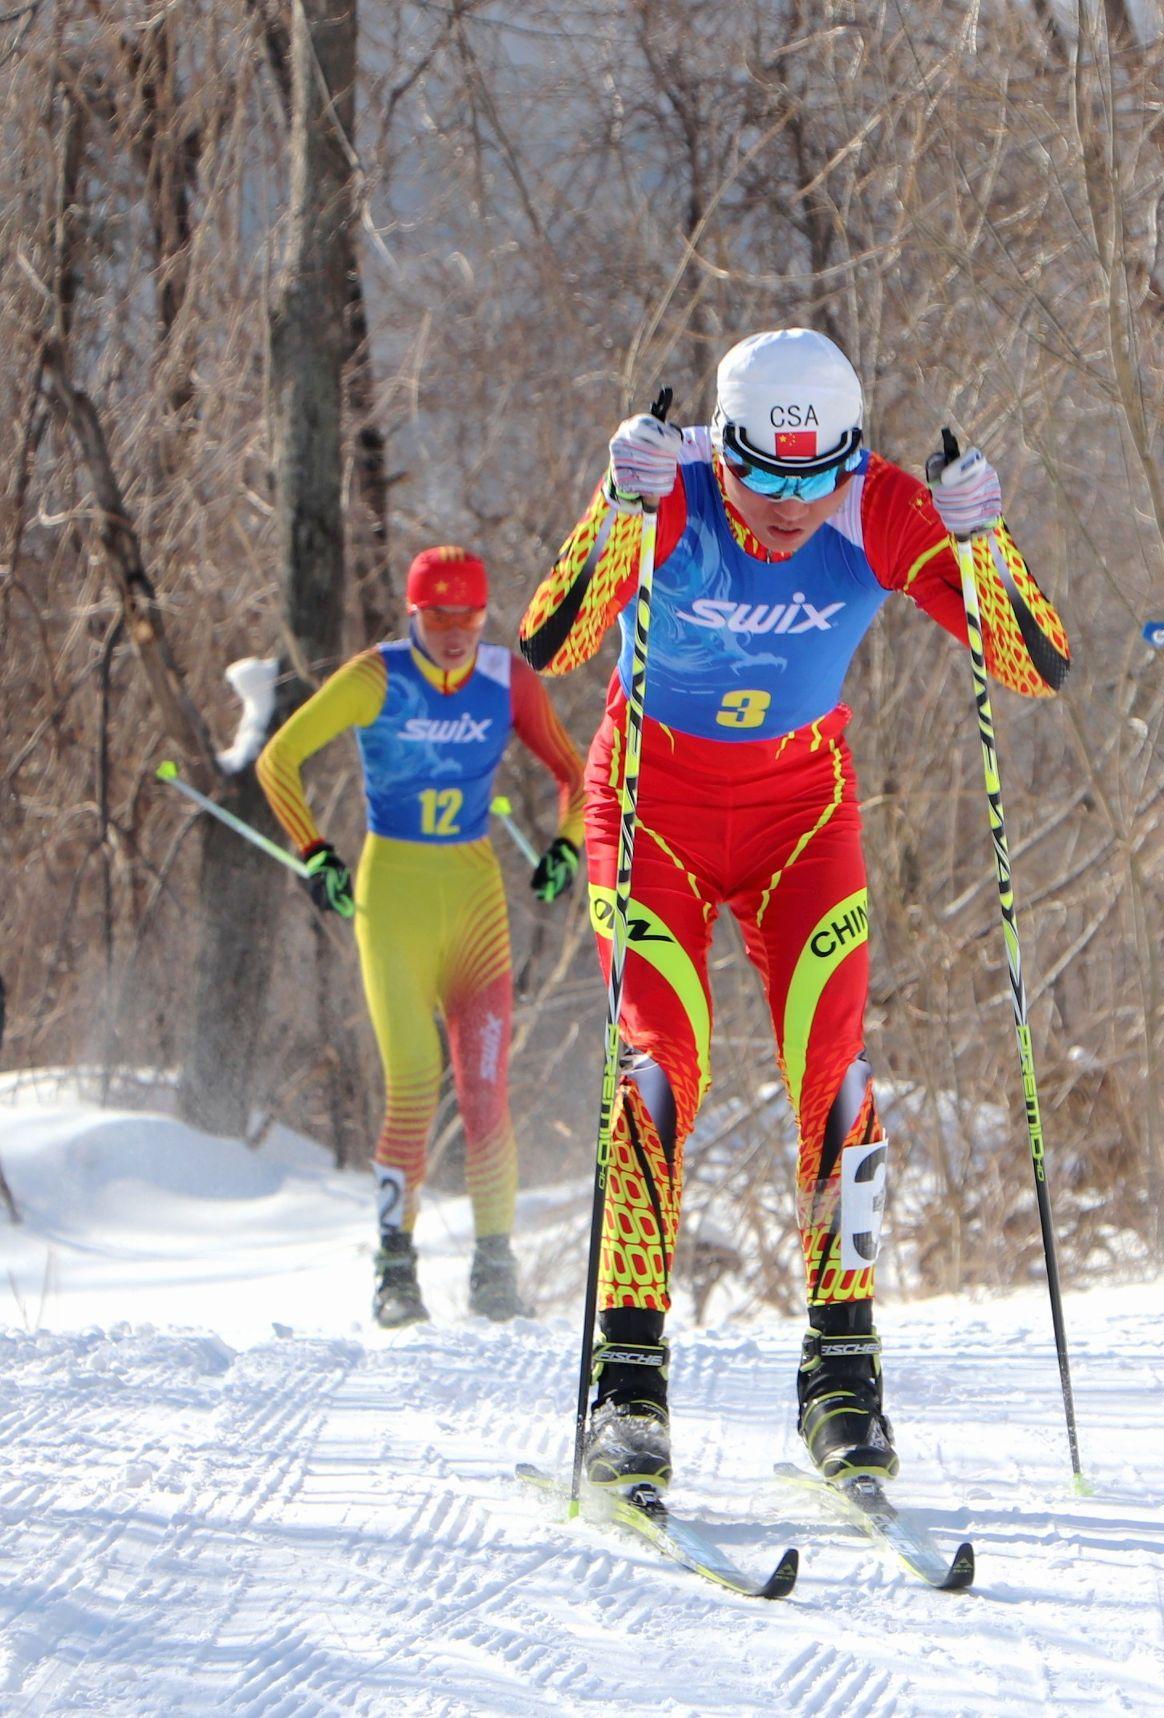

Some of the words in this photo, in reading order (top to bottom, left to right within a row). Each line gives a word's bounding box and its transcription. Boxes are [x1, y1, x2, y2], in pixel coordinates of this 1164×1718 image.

[770, 404, 819, 428] CSA
[716, 690, 771, 728] 3
[419, 788, 463, 836] 12
